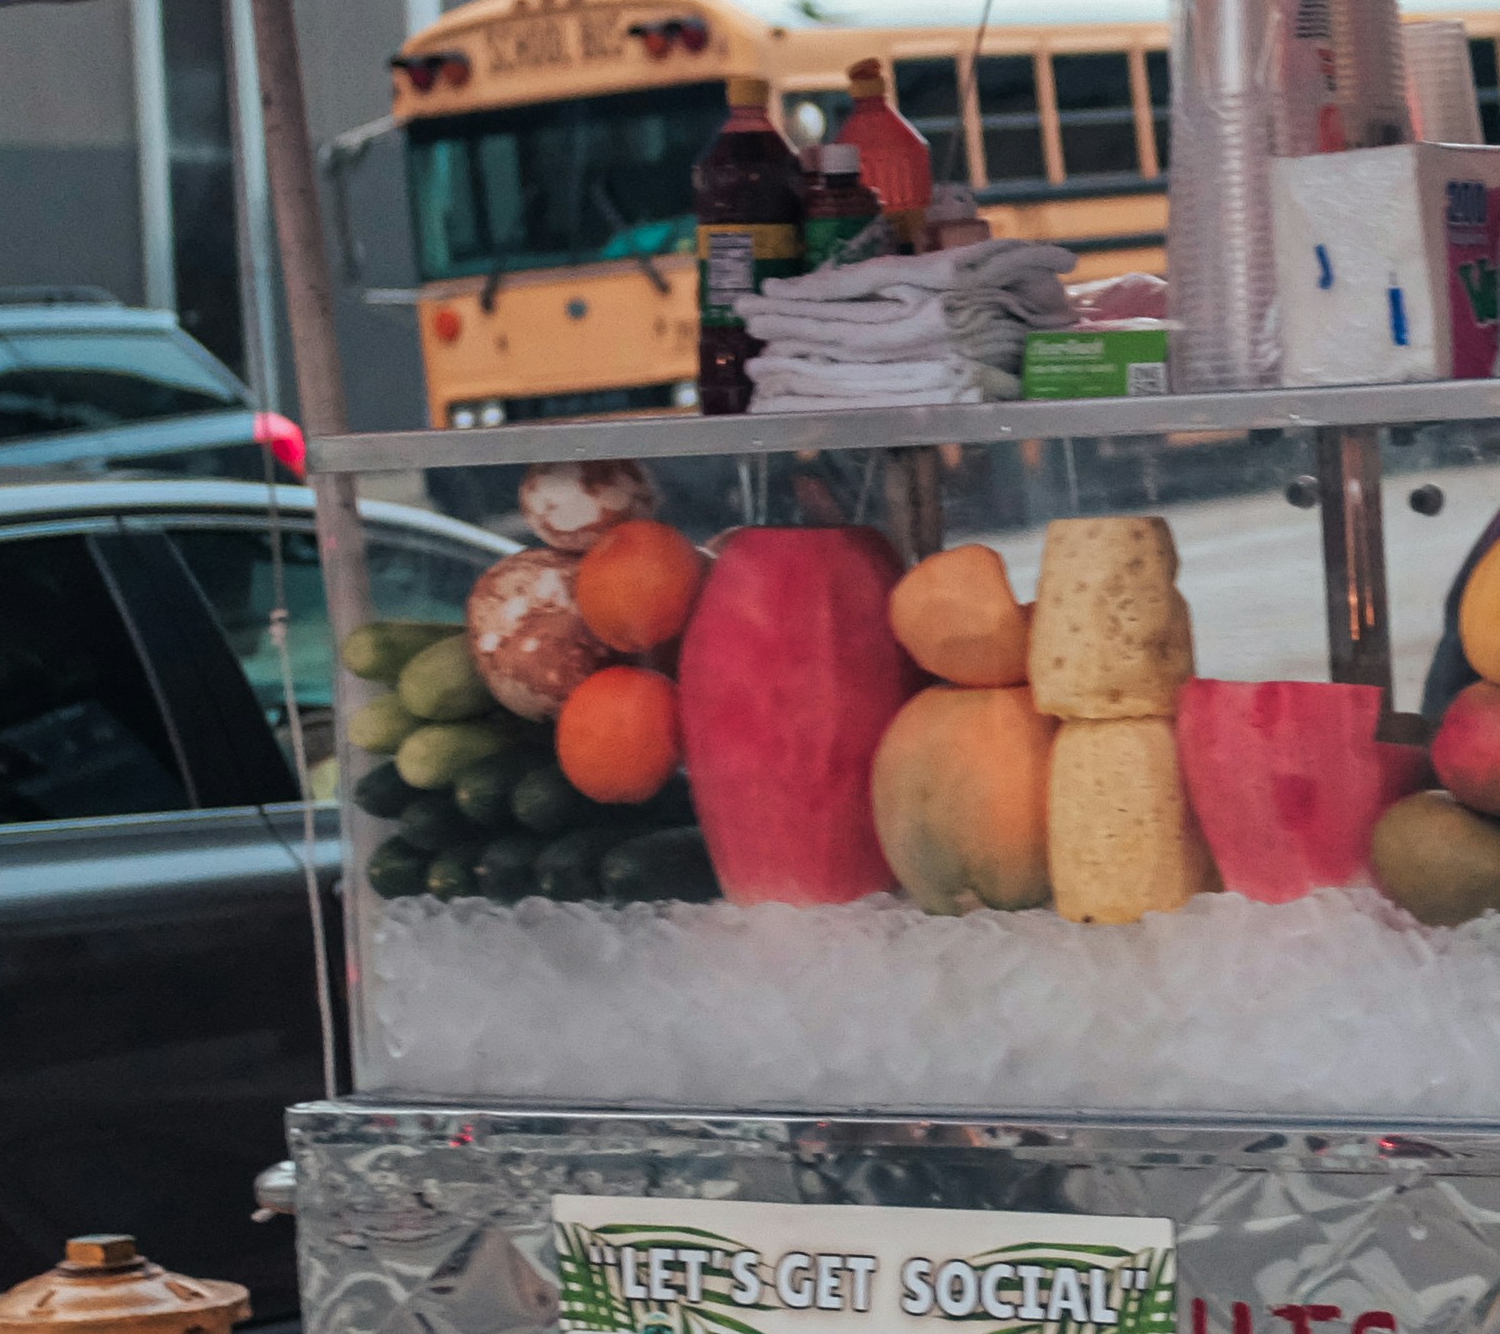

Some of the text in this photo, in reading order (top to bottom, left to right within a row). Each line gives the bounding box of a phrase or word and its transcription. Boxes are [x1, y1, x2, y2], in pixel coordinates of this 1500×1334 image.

[482, 19, 571, 75] SCHOOL
[589, 1244, 1148, 1326] "LET'S GET SOCIAL"
